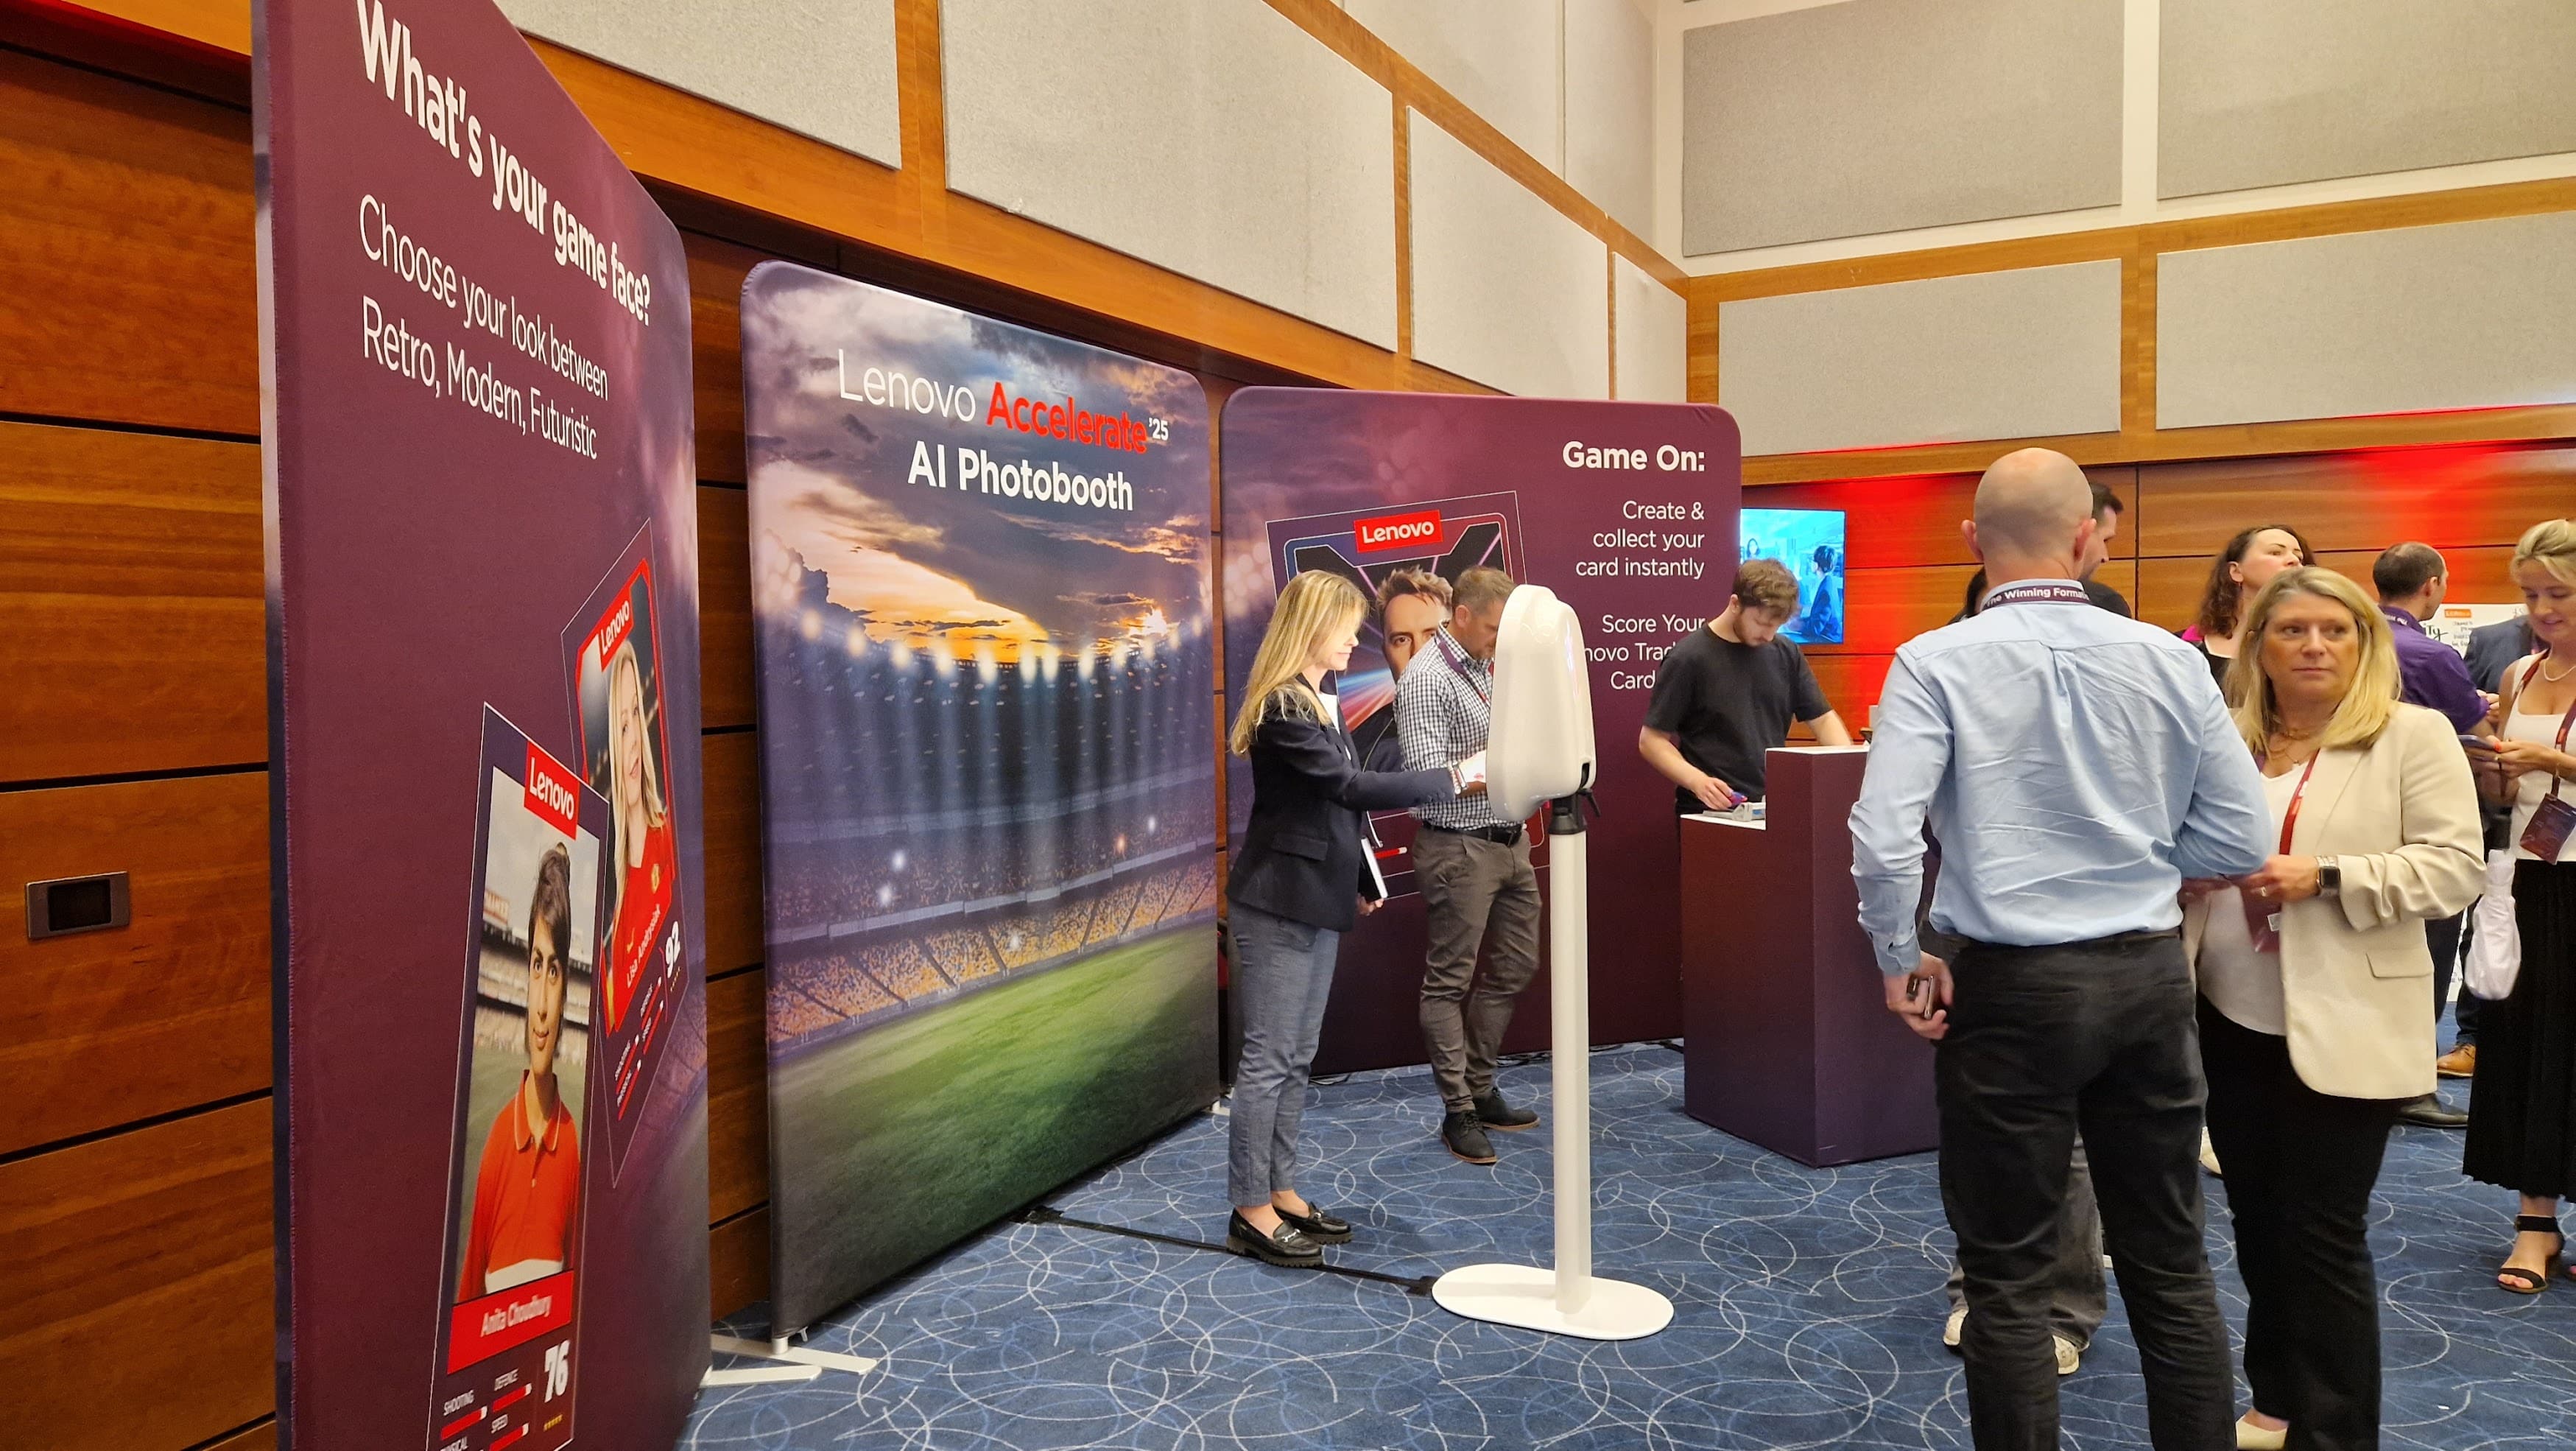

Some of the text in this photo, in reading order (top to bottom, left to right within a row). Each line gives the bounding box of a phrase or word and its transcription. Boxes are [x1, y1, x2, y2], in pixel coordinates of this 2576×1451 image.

[358, 0, 650, 326] What's your game face?
[359, 194, 608, 401] Choose your look between
[363, 295, 597, 460] Retro, Modern, Futuristic
[838, 349, 976, 422] Lenovo
[985, 382, 1147, 453] Accelerate
[907, 440, 1133, 510] AI Photobooth
[1563, 440, 1706, 472] Game On:
[1362, 521, 1435, 544] Lenovo
[1623, 500, 1705, 520] Create &
[1593, 529, 1705, 552] collect your
[1576, 558, 1705, 580] card instantly
[2004, 588, 2052, 600] Winning
[600, 600, 630, 656] Lenovo
[1602, 614, 1706, 633] Score Your
[1584, 646, 1630, 661] novo
[529, 756, 574, 821] Lenovo
[666, 921, 680, 978] 92
[543, 1339, 571, 1404] 76
